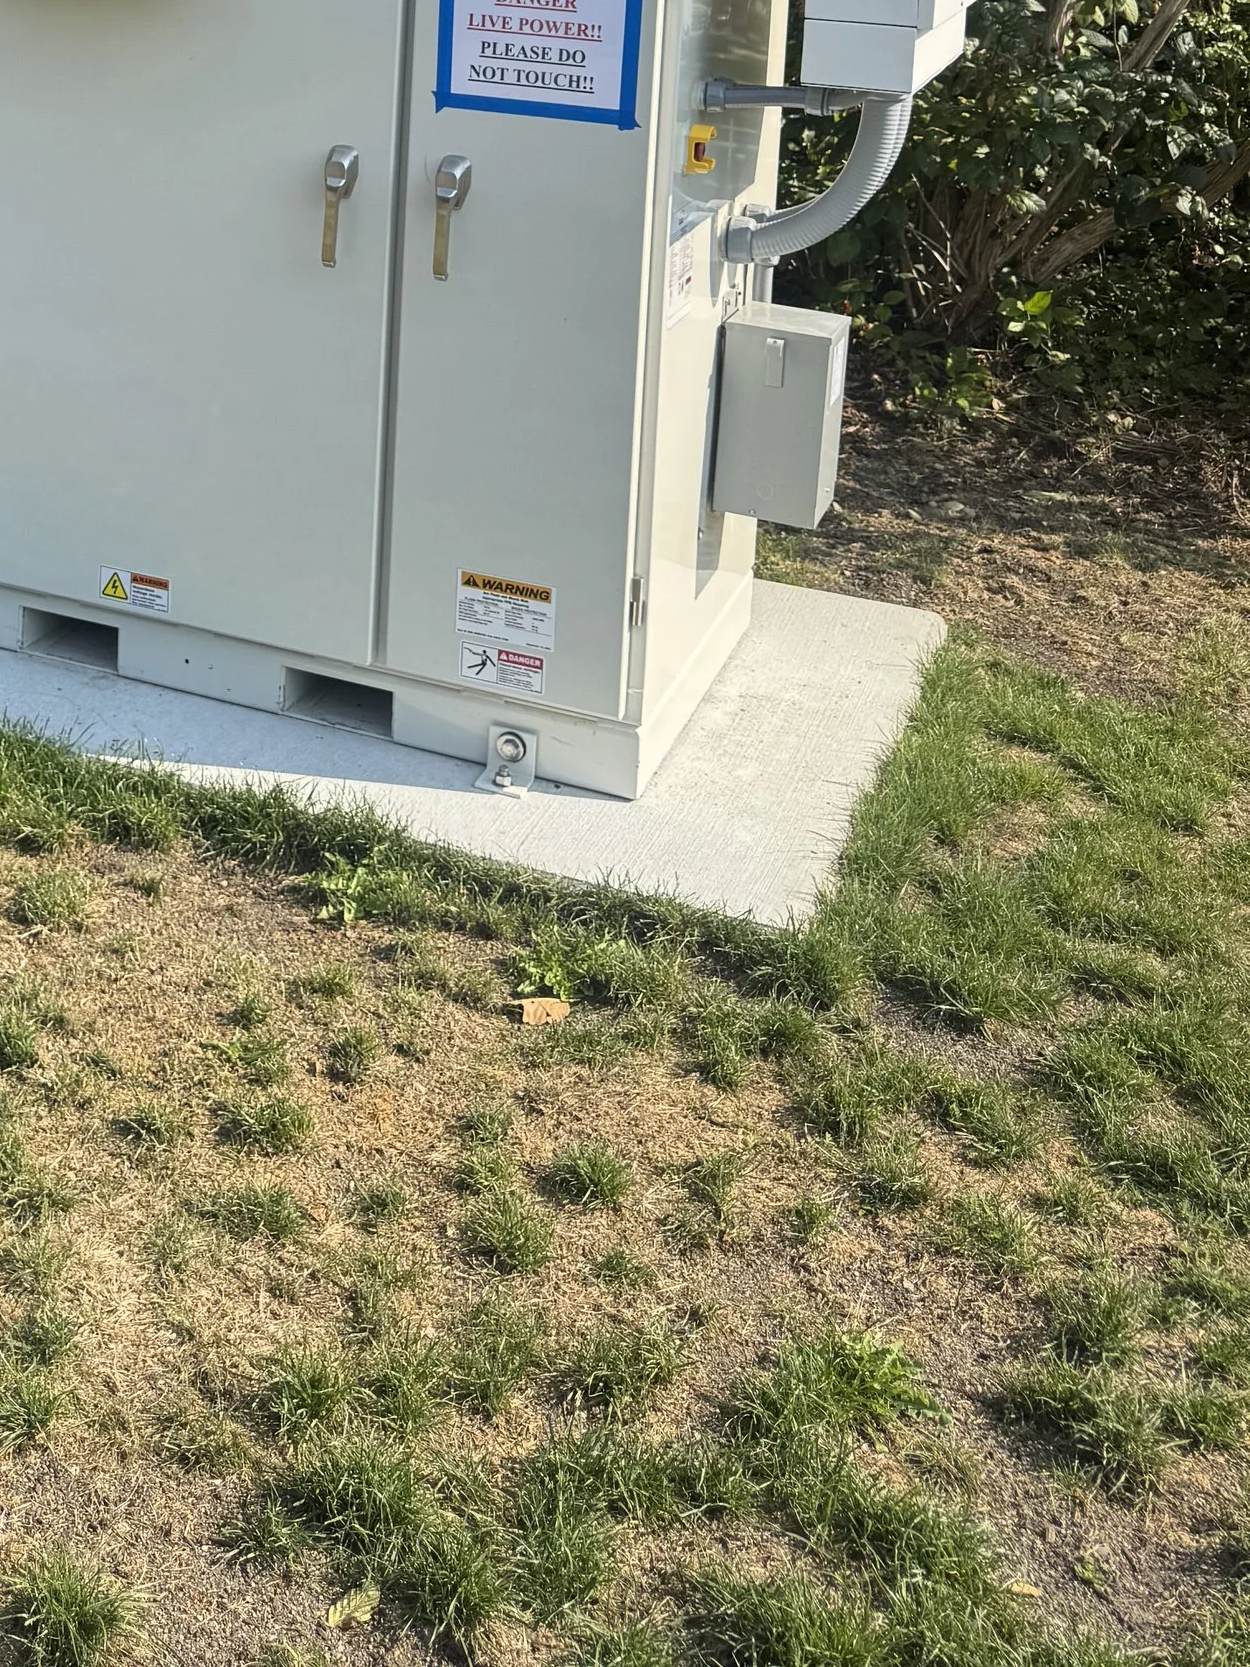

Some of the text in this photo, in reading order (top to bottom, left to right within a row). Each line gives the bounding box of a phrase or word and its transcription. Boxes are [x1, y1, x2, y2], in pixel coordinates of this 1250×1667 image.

[468, 13, 602, 38] LIVE POWER!!
[480, 41, 586, 64] PLEASE DO
[469, 64, 594, 90] NOT TOUCH!!
[482, 578, 550, 601] WARNING
[508, 654, 541, 667] DANGER
